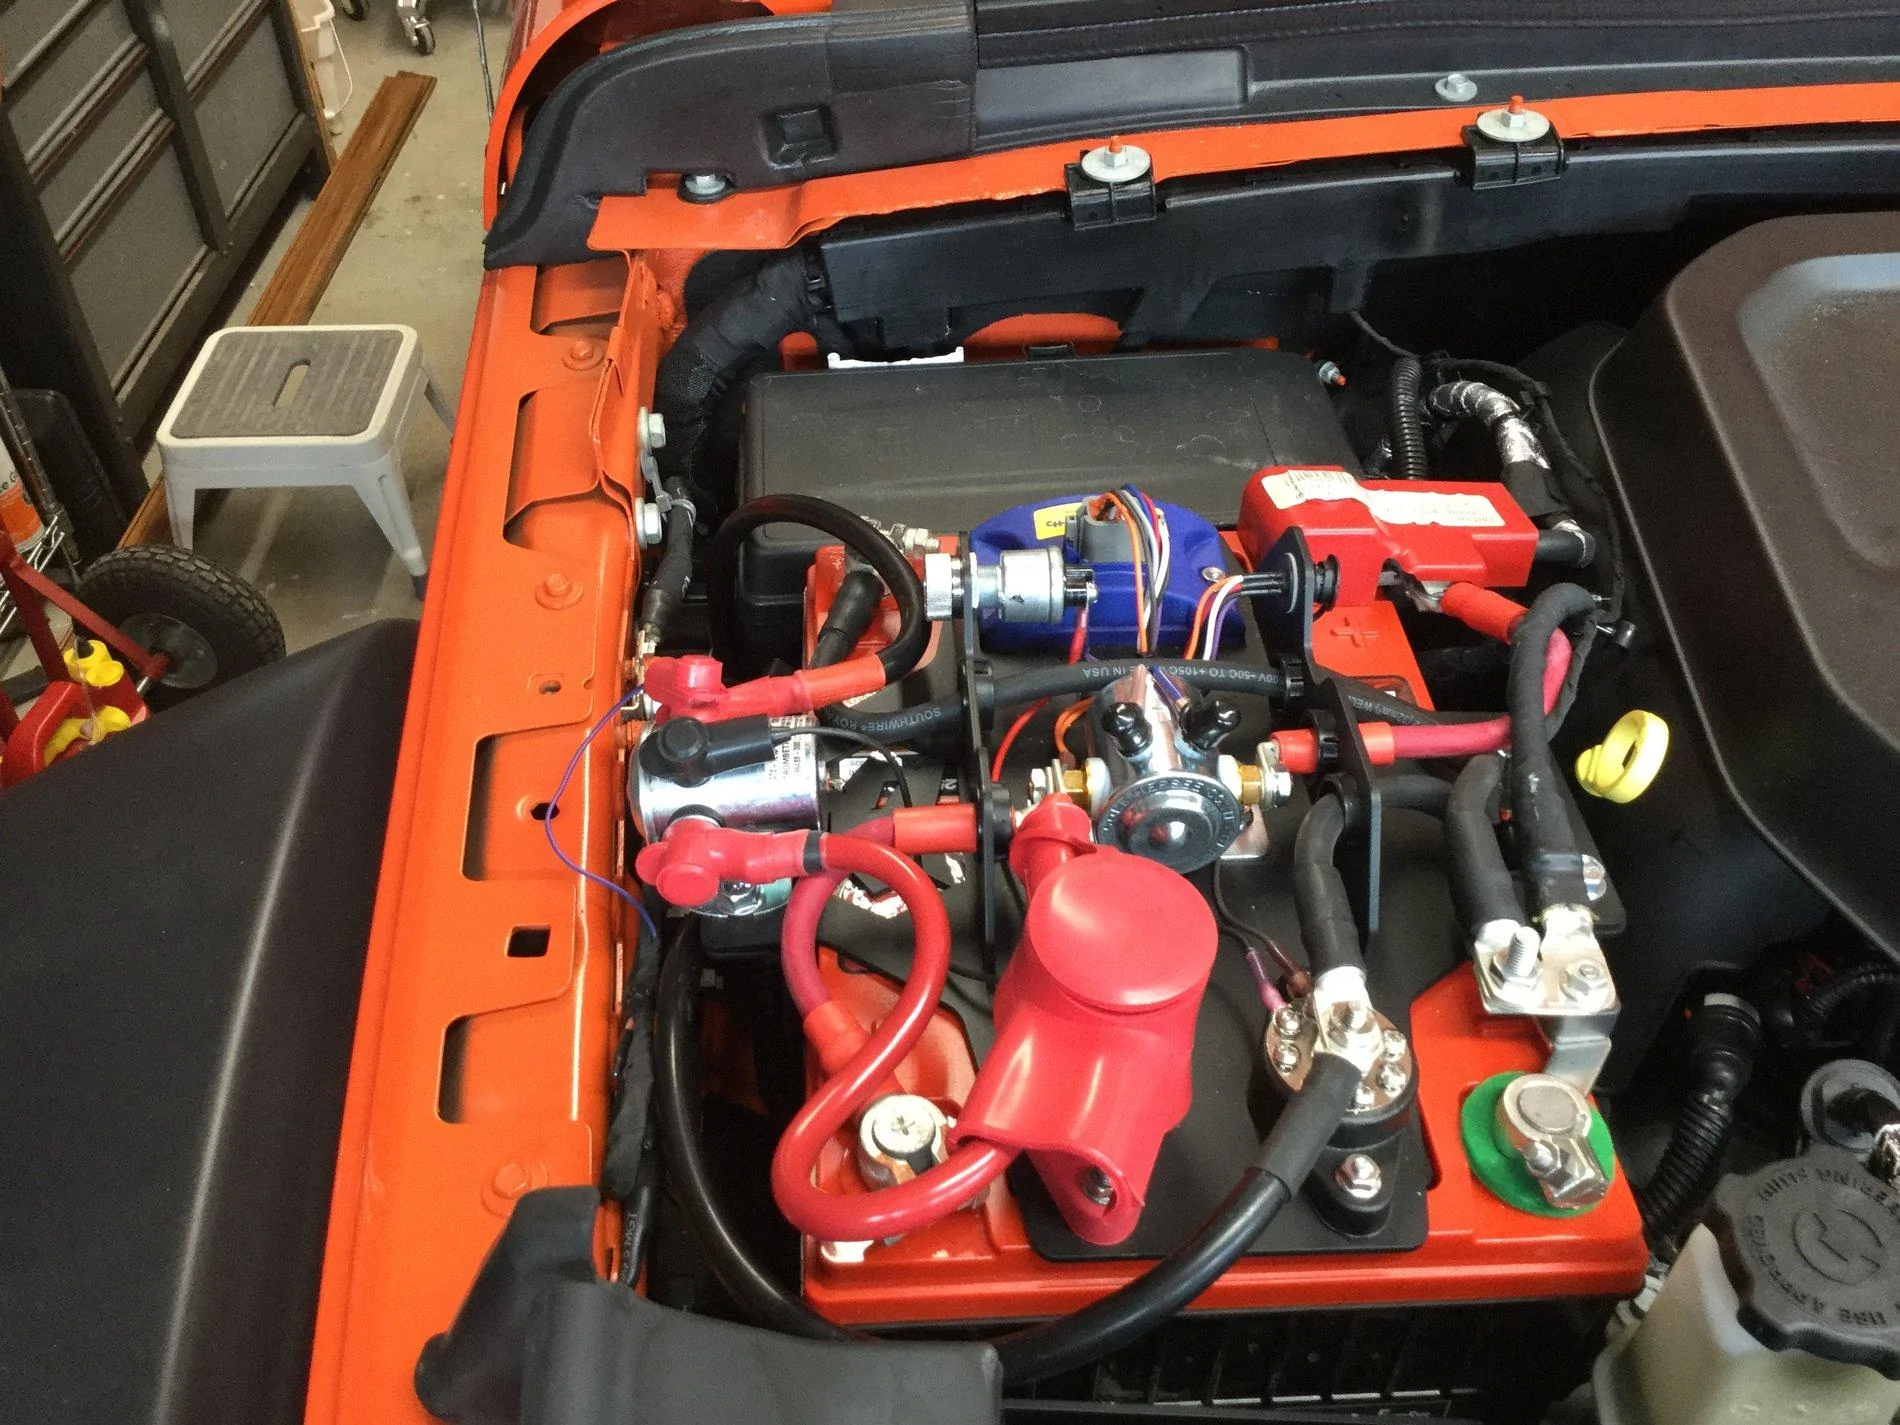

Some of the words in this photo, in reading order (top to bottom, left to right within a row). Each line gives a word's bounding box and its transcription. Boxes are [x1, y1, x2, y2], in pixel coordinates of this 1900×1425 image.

[1082, 667, 1110, 678] USA
[1112, 666, 1126, 676] IN
[1169, 666, 1207, 677] +105C
[1209, 668, 1226, 678] TO
